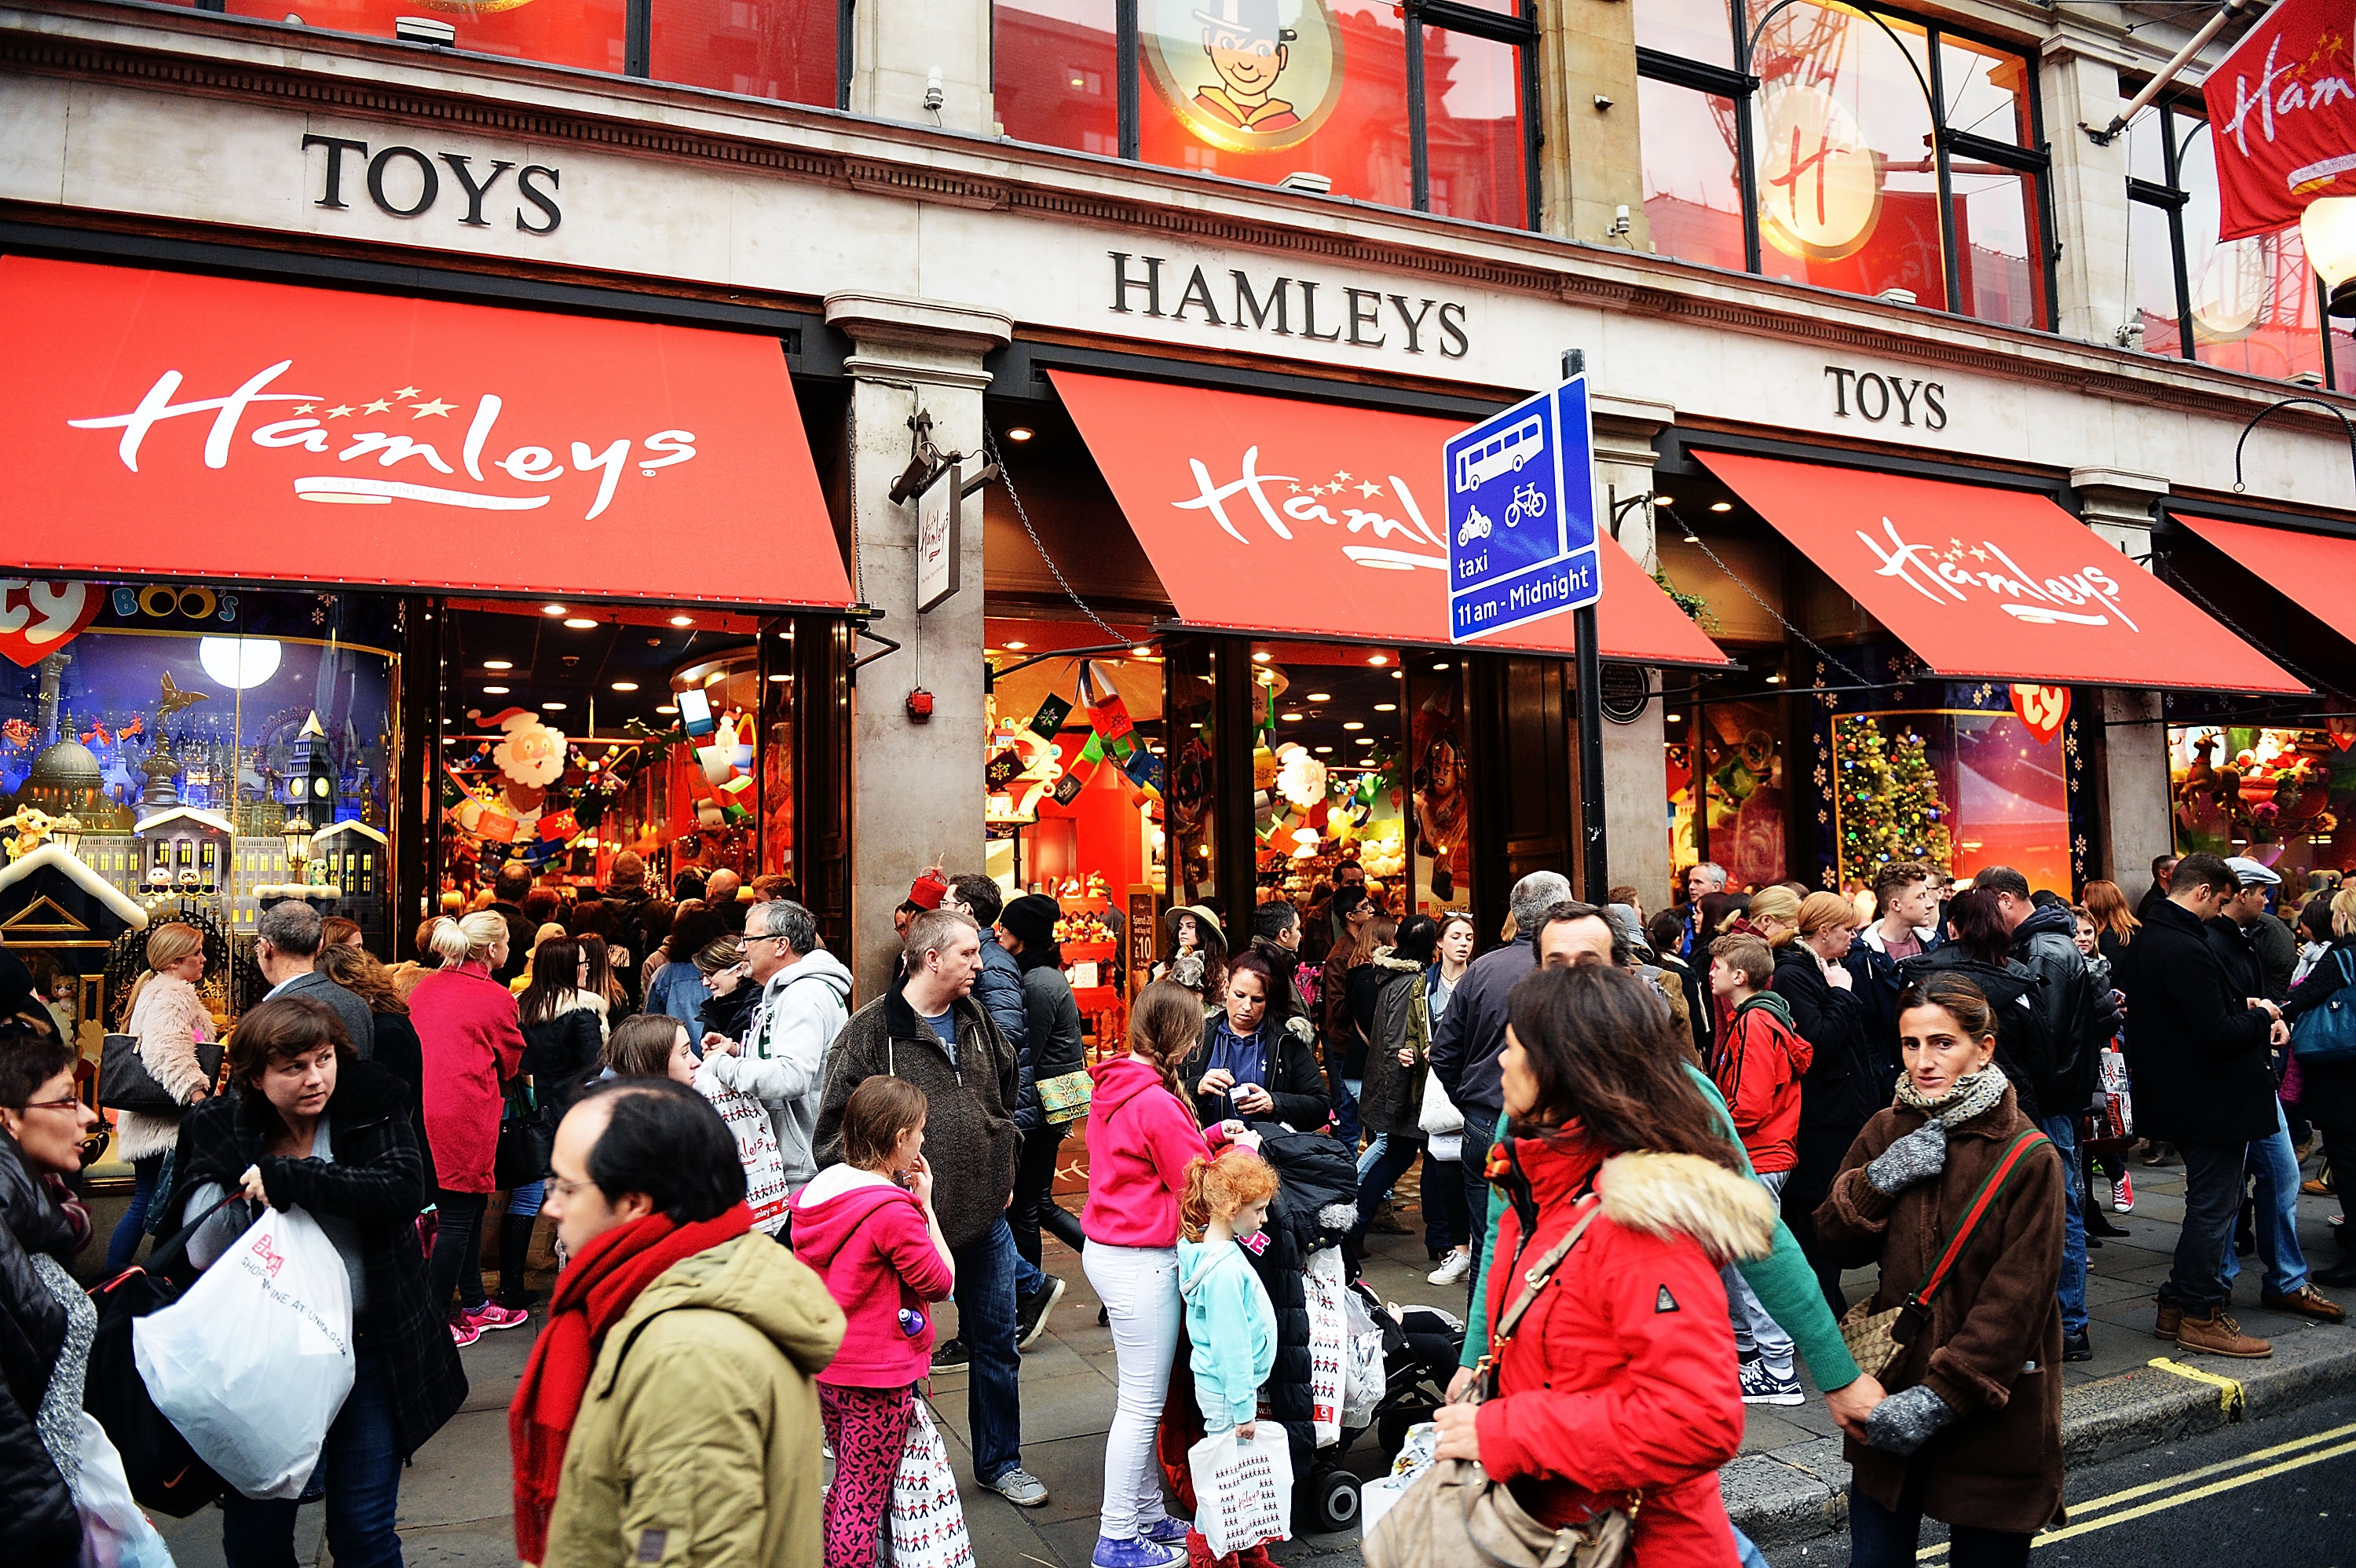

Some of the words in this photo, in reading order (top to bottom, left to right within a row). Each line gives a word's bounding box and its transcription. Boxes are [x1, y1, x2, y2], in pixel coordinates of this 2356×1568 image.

[302, 133, 562, 235] TOYS
[1108, 251, 1469, 358] HAMLEYS
[1824, 365, 1948, 430] TOYS
[68, 360, 697, 520] Hamleys
[920, 510, 949, 563] Hamleys
[1458, 549, 1488, 579] taxi
[112, 583, 239, 622] BOO'S
[1509, 565, 1589, 611] Midnight
[1857, 516, 2138, 633] Hamleys
[291, 1300, 306, 1312] AT
